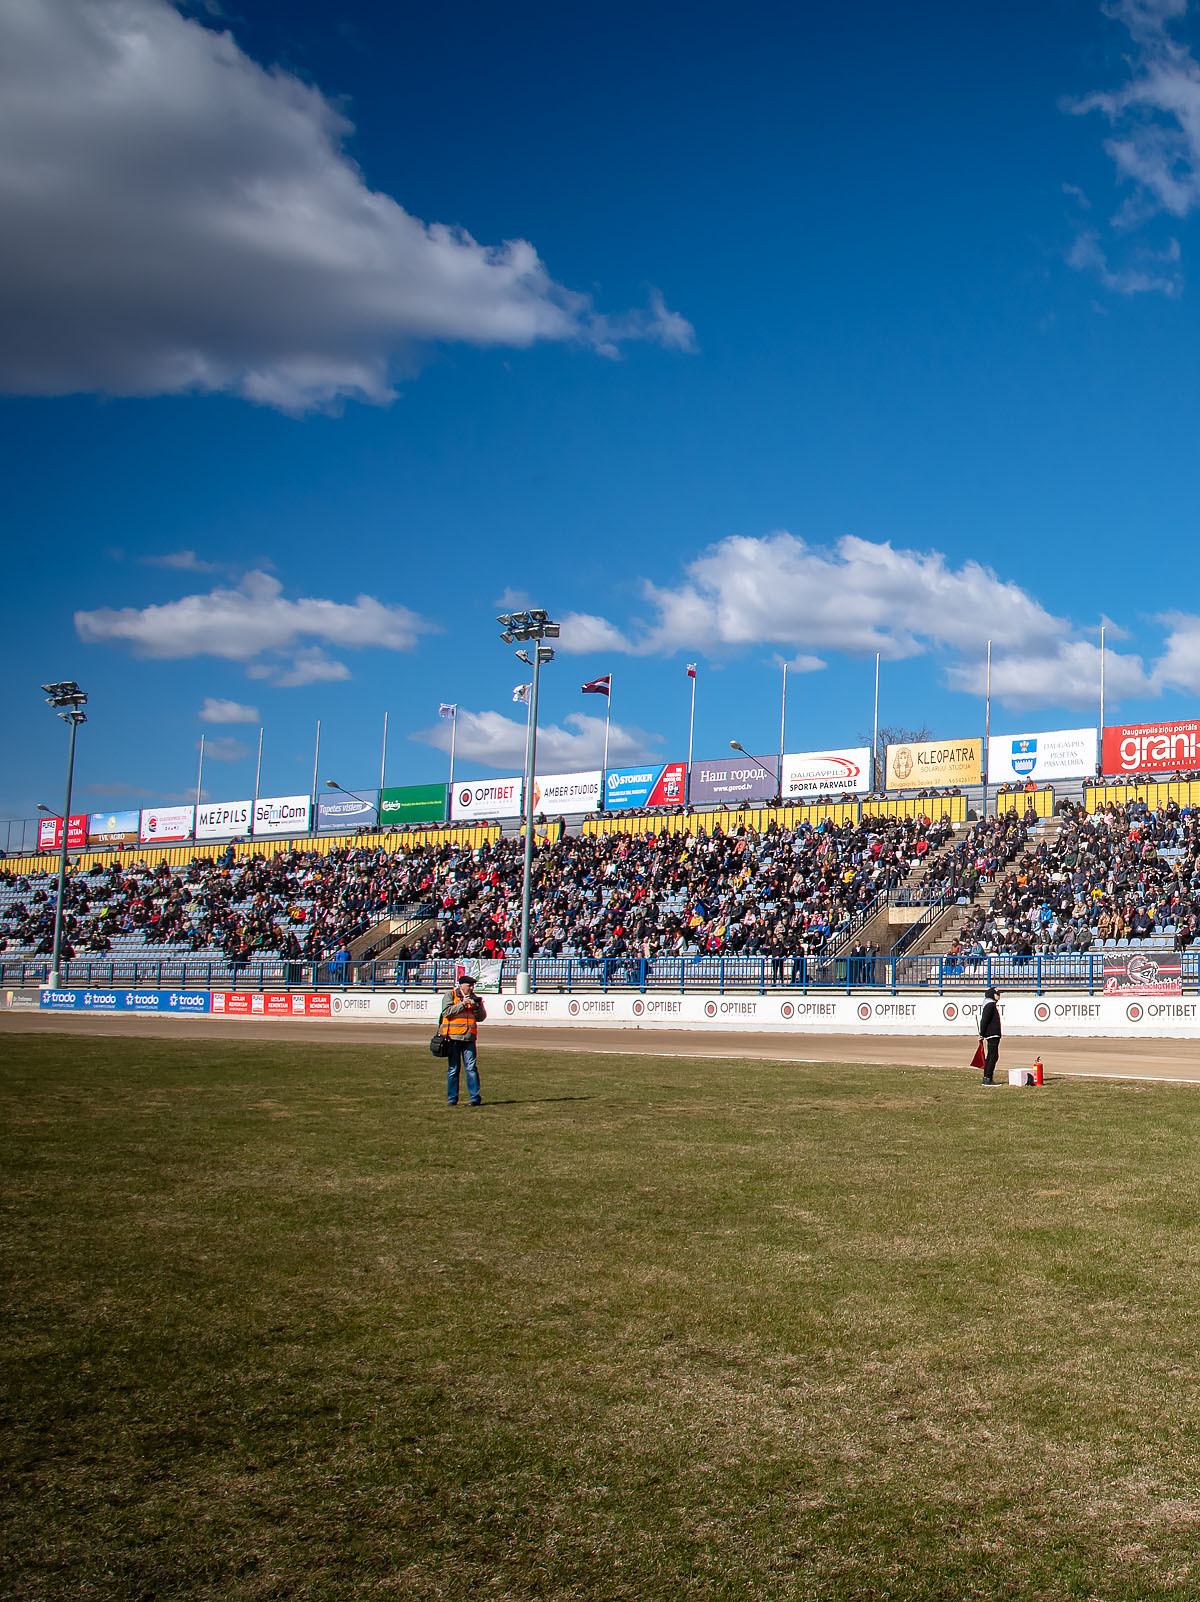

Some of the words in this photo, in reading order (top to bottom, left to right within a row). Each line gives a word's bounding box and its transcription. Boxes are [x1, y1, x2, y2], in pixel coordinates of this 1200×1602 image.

[1122, 726, 1158, 736] Daugavpils
[1159, 725, 1173, 733] ziņu
[1174, 723, 1198, 732] portāls
[917, 747, 975, 765] KLEOPATRA
[1141, 759, 1197, 768] www.grani.lv
[619, 773, 653, 785] STOKKER
[700, 769, 727, 783] Наш
[790, 768, 846, 780] DAUGAVPILS
[544, 786, 569, 797] AMBER
[569, 783, 598, 796] STUDIOS
[713, 783, 753, 793] www.gorod.lv
[789, 782, 818, 792] SPORTA
[819, 779, 857, 791] PĀRVALDE
[475, 786, 514, 801] OPTIBET
[199, 808, 247, 826] MEŽPILS
[256, 804, 306, 821] SemiCom
[51, 992, 76, 1003] trodo
[93, 993, 117, 1004] trodo
[134, 994, 159, 1005] trodo
[179, 995, 205, 1006] trodo
[344, 999, 371, 1009] OPTIBET
[400, 1000, 428, 1010] OPTIBET
[517, 1000, 549, 1012] OPTIBET
[582, 1001, 615, 1012] OPTIBET
[647, 1001, 682, 1013] OPTIBET
[720, 1002, 757, 1014] OPTIBET
[797, 1003, 836, 1015] OPTIBET
[875, 1004, 916, 1016] OPTIBET
[962, 1004, 1006, 1016] OPTT
[1054, 1004, 1101, 1017] OPTIBET
[1147, 1004, 1197, 1017] OPTIBET
